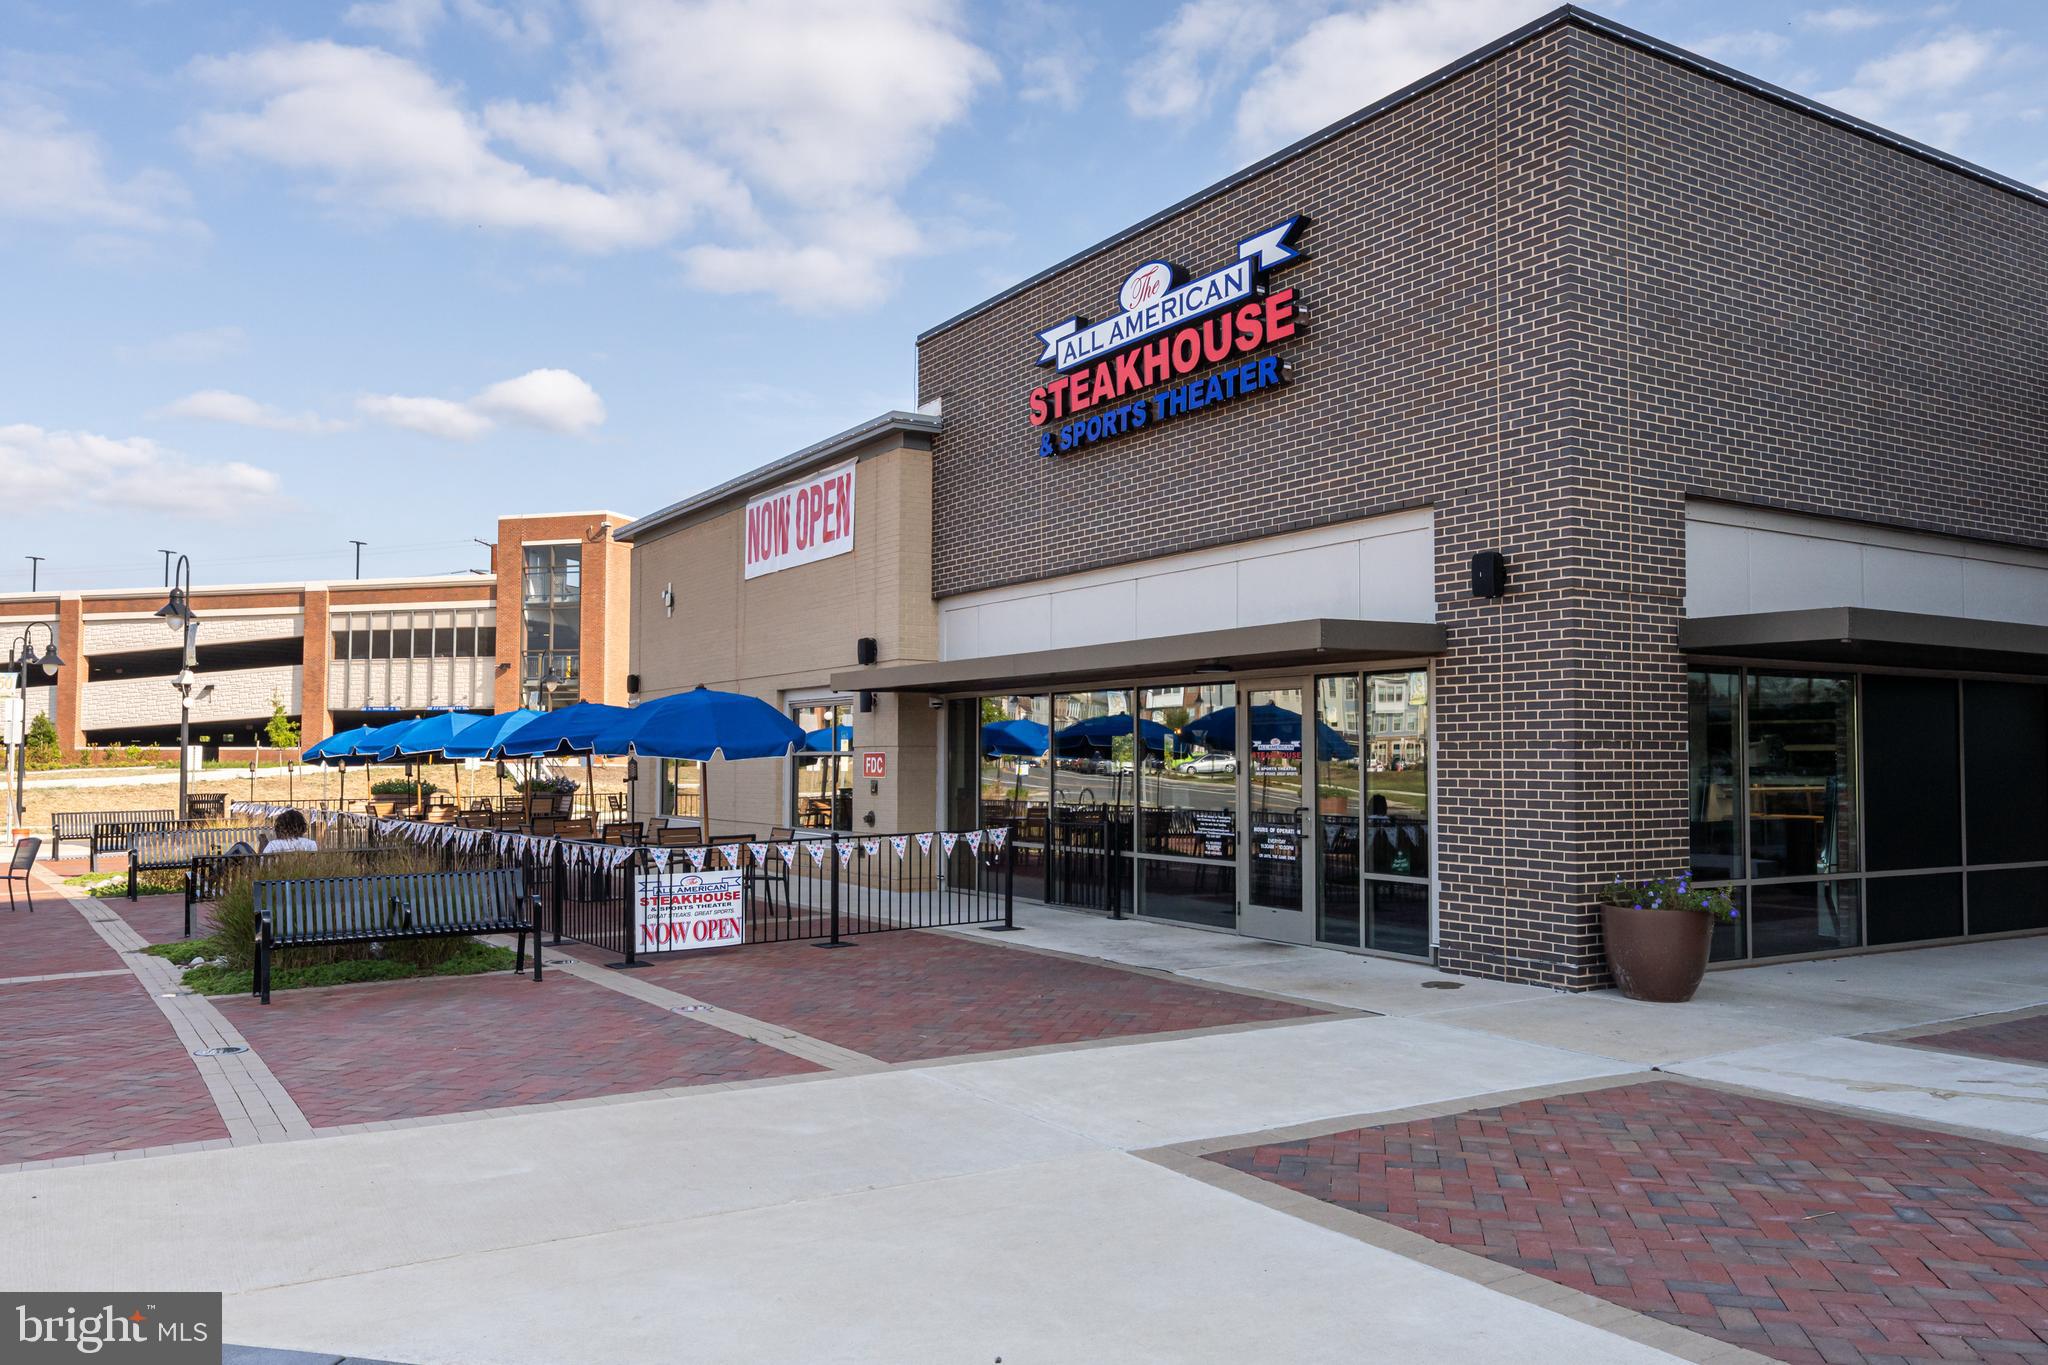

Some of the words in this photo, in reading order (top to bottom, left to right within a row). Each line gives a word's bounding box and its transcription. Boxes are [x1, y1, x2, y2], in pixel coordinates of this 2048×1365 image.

[1129, 265, 1160, 309] The
[1062, 332, 1104, 364] ALL
[1108, 267, 1244, 352] AMERICAN
[1029, 288, 1296, 426] STEAKHOUSE
[1038, 432, 1054, 458] &
[1060, 400, 1147, 450] SPORTS
[1154, 355, 1279, 420] THEATER
[748, 494, 791, 565] NOW
[796, 473, 852, 551] OPEN
[866, 757, 883, 774] FDC
[639, 890, 741, 907] STEAKHOUSE
[677, 883, 726, 893] AMERICAN
[695, 901, 732, 909] THEATER
[639, 920, 691, 946] NOW
[692, 916, 742, 943] OPEN
